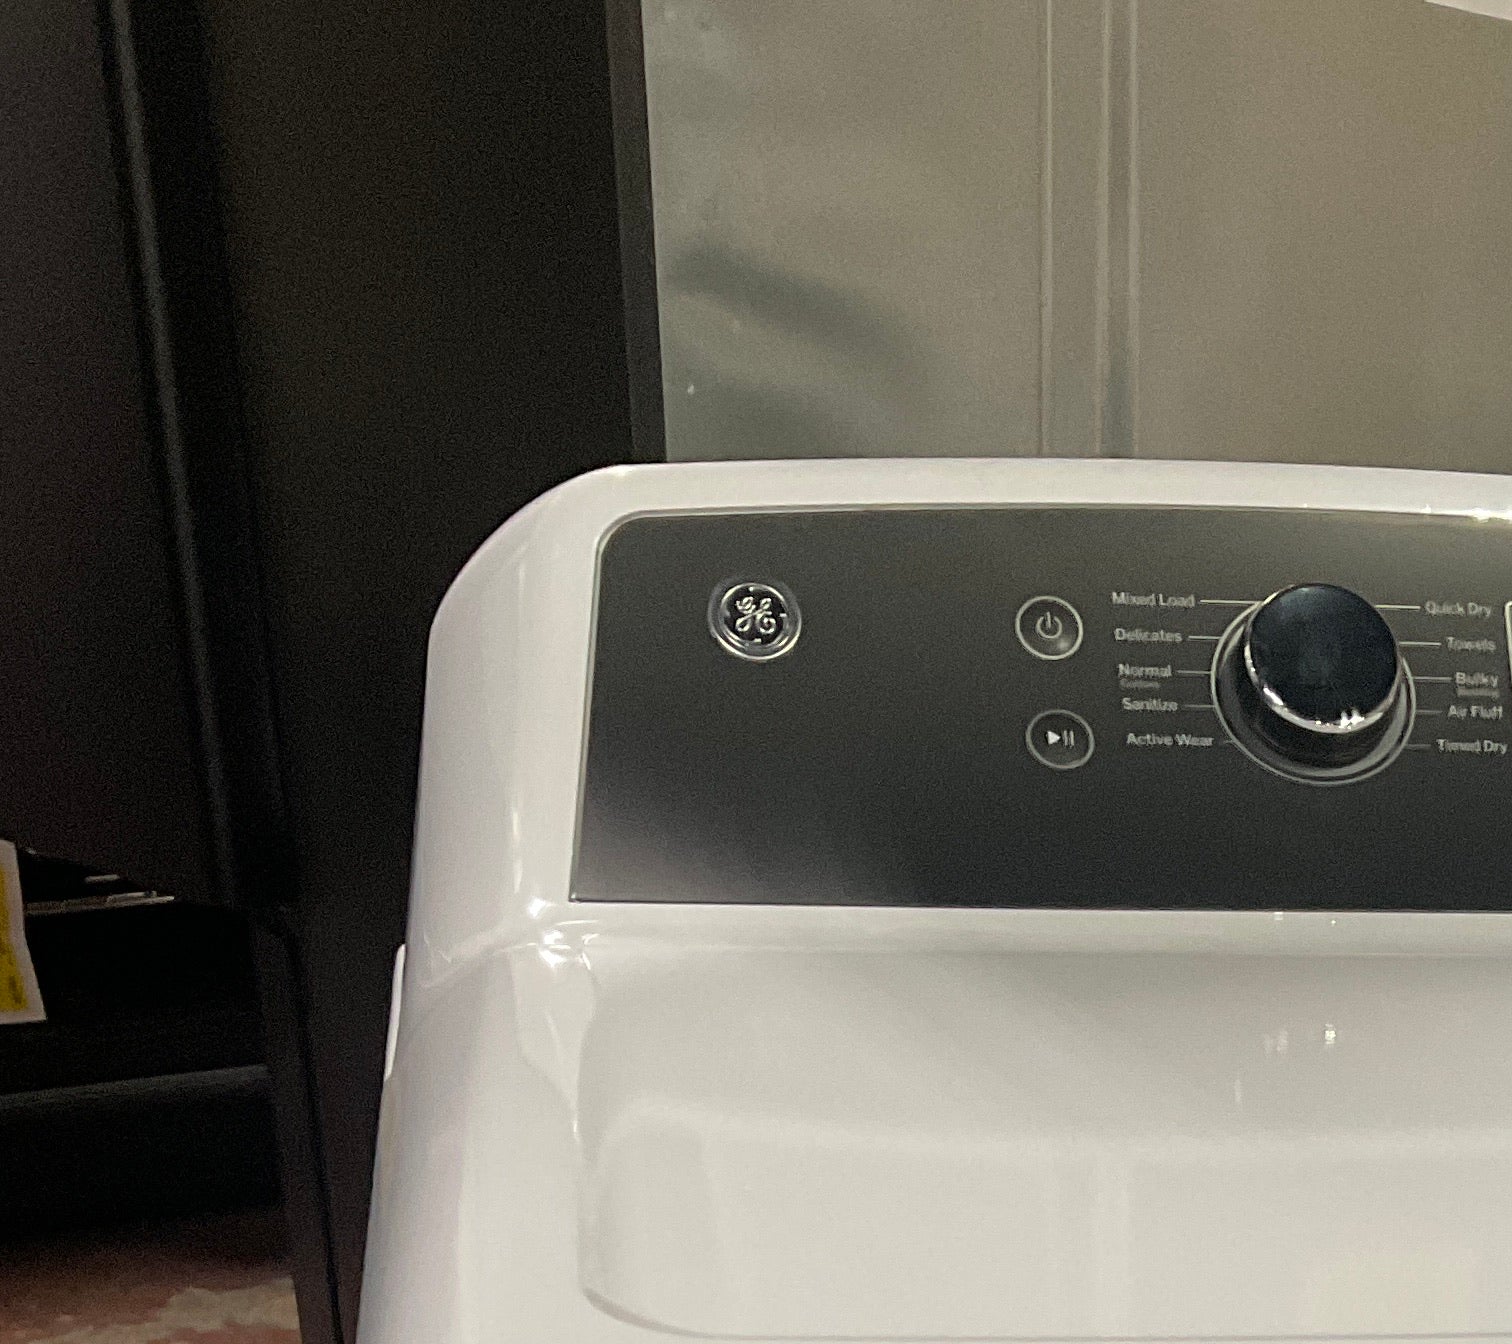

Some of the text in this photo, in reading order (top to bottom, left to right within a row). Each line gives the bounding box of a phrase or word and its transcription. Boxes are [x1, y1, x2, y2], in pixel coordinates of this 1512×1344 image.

[1112, 592, 1196, 607] Mixed Load
[1425, 600, 1491, 618] Quick Dry
[1114, 628, 1183, 642] Delicates
[1447, 637, 1497, 651] Towels
[1118, 664, 1172, 677] Normal
[1455, 672, 1499, 687] Bulky
[1122, 698, 1179, 711] Sanitize
[1126, 733, 1215, 746] Active Wear
[1435, 739, 1508, 754] Timed Dry
